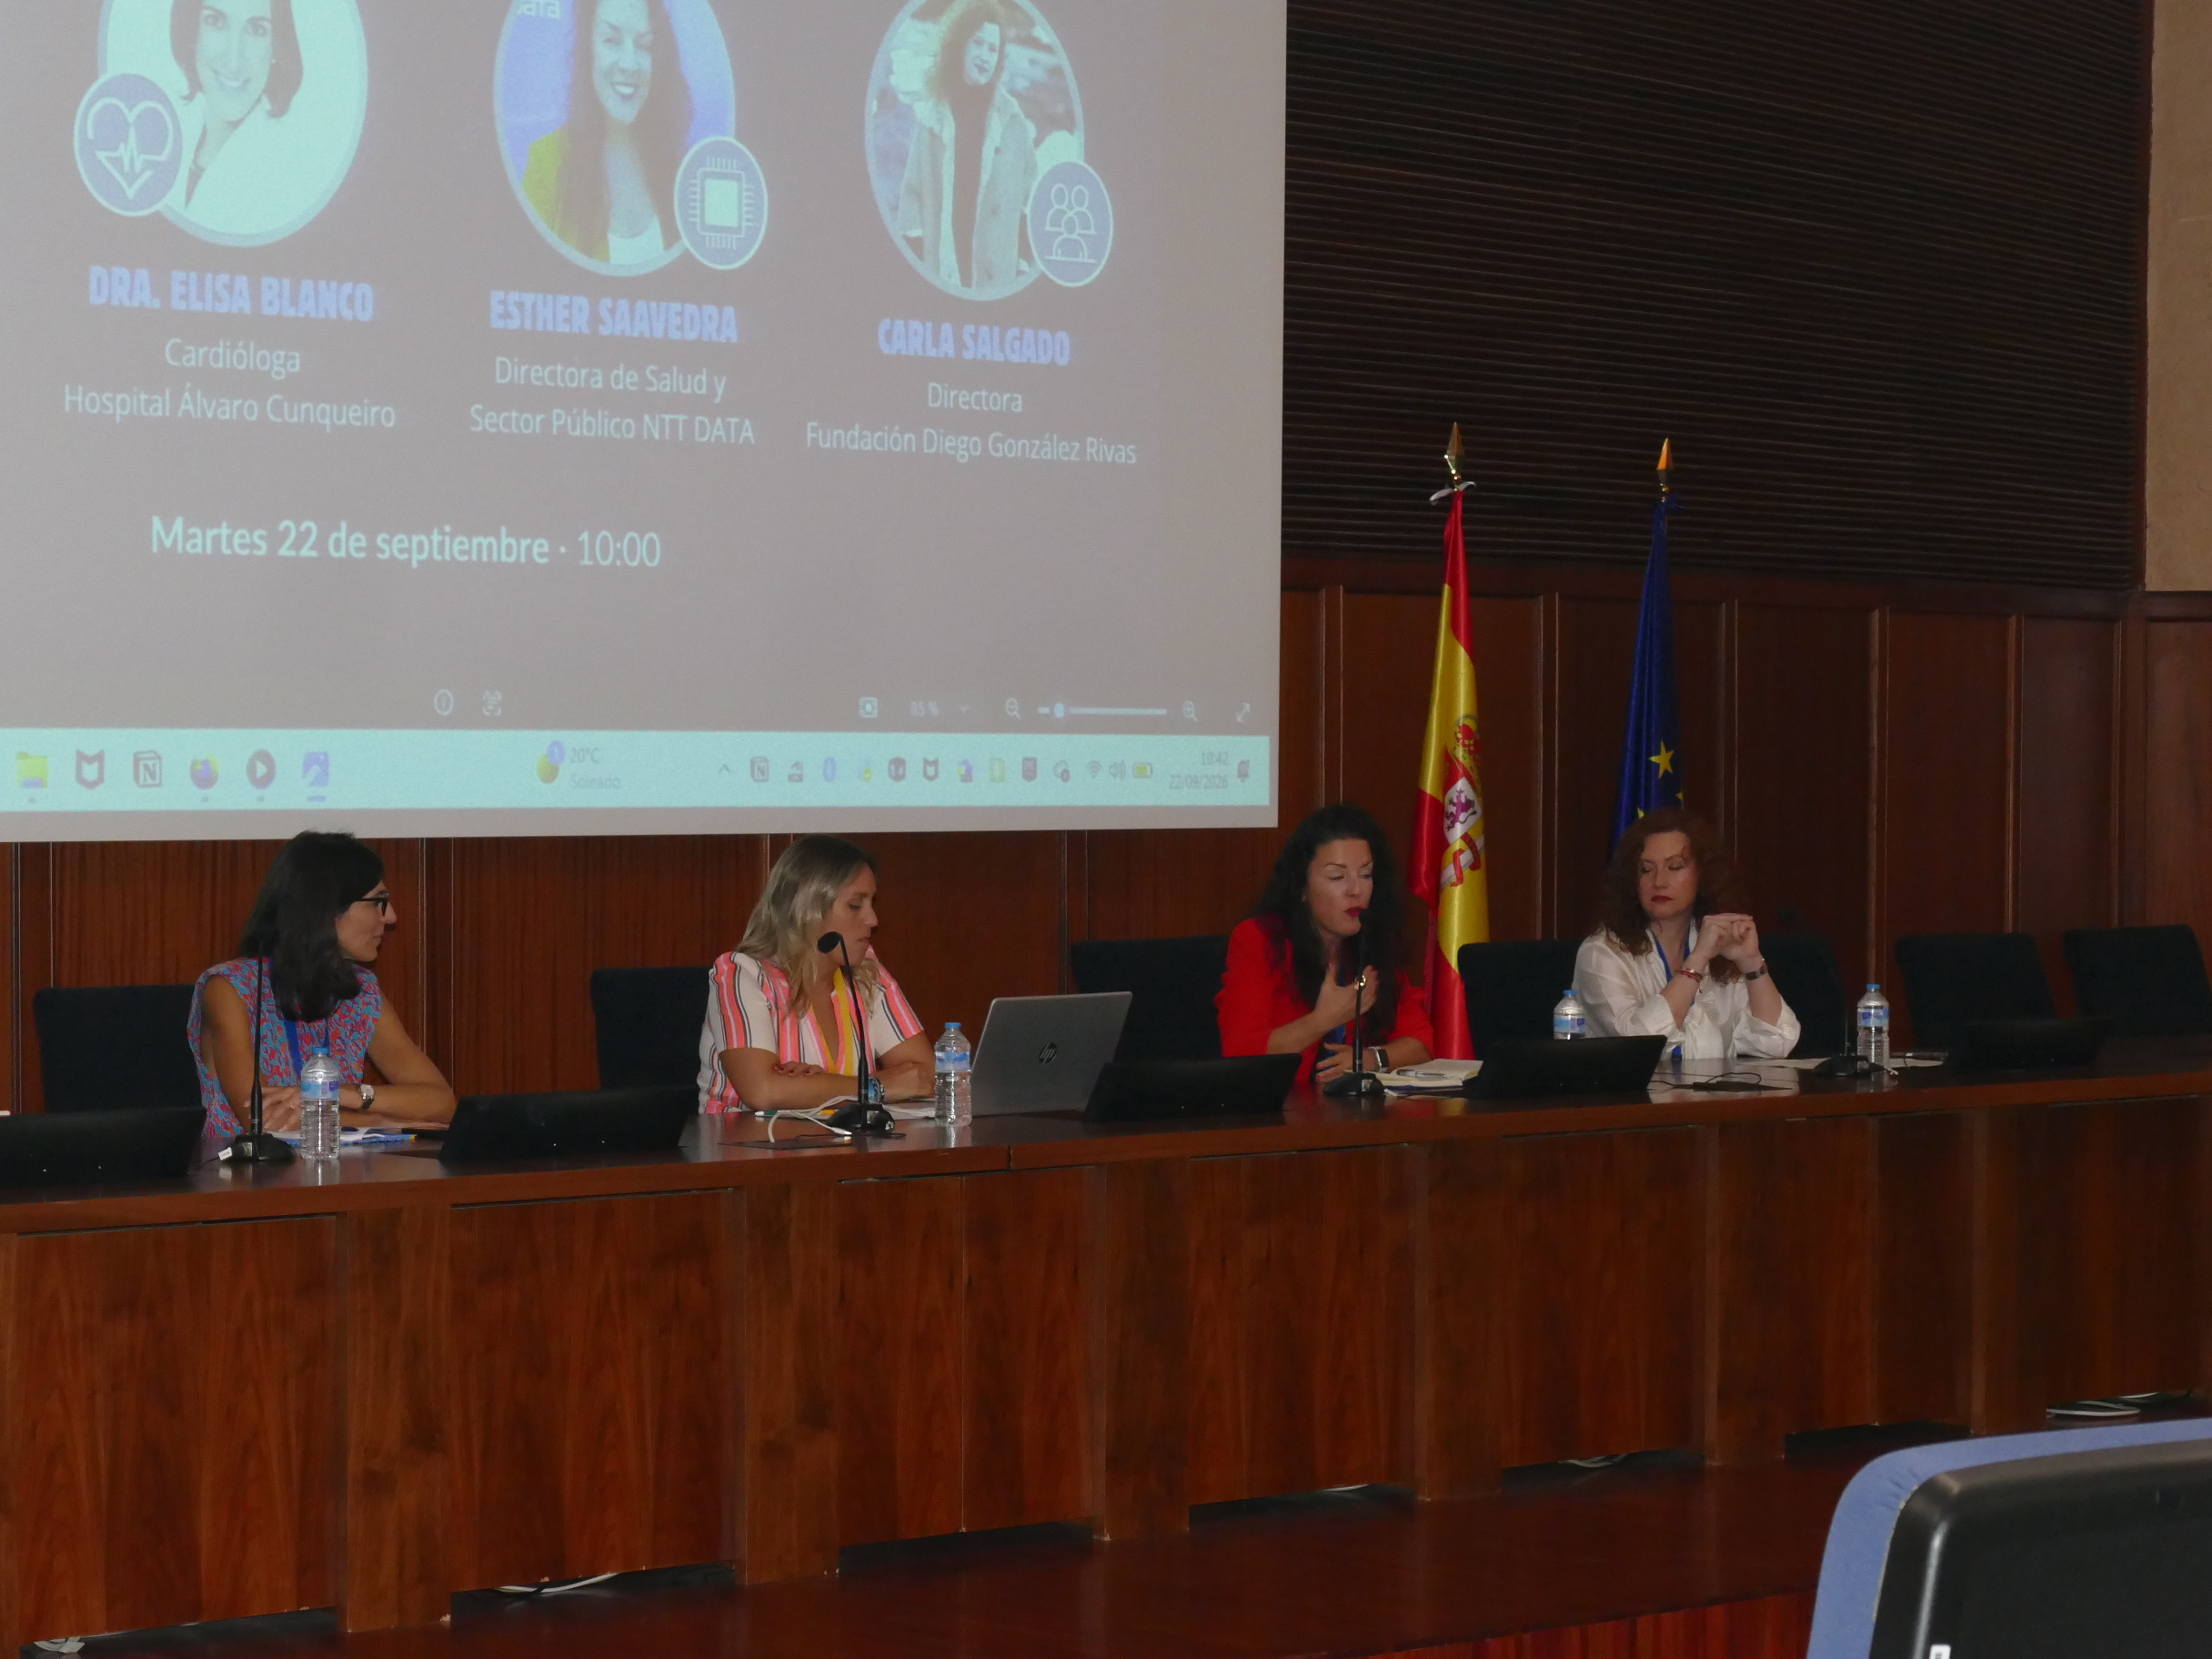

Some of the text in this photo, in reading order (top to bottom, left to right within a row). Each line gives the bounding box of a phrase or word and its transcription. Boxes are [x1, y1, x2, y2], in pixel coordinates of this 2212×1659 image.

[88, 266, 376, 322] DRA. ELISA BLANCO
[489, 290, 739, 343] ESTHER SAAVEDRA
[164, 337, 302, 379] Cardióloga
[878, 318, 1071, 366] CARLA SALGADO
[494, 356, 728, 404] Directora de Salud y
[927, 382, 1024, 414] Directora
[64, 382, 397, 432] Hospital Álvaro Cunqueiro
[469, 404, 756, 446] Sector Público NTT DATA
[806, 421, 1137, 464] Fundación Diego González Rivas
[151, 516, 268, 557] Martes
[277, 519, 319, 558] 22
[327, 521, 367, 559] de
[376, 525, 550, 568] septiembre
[578, 530, 662, 568] 10:00
